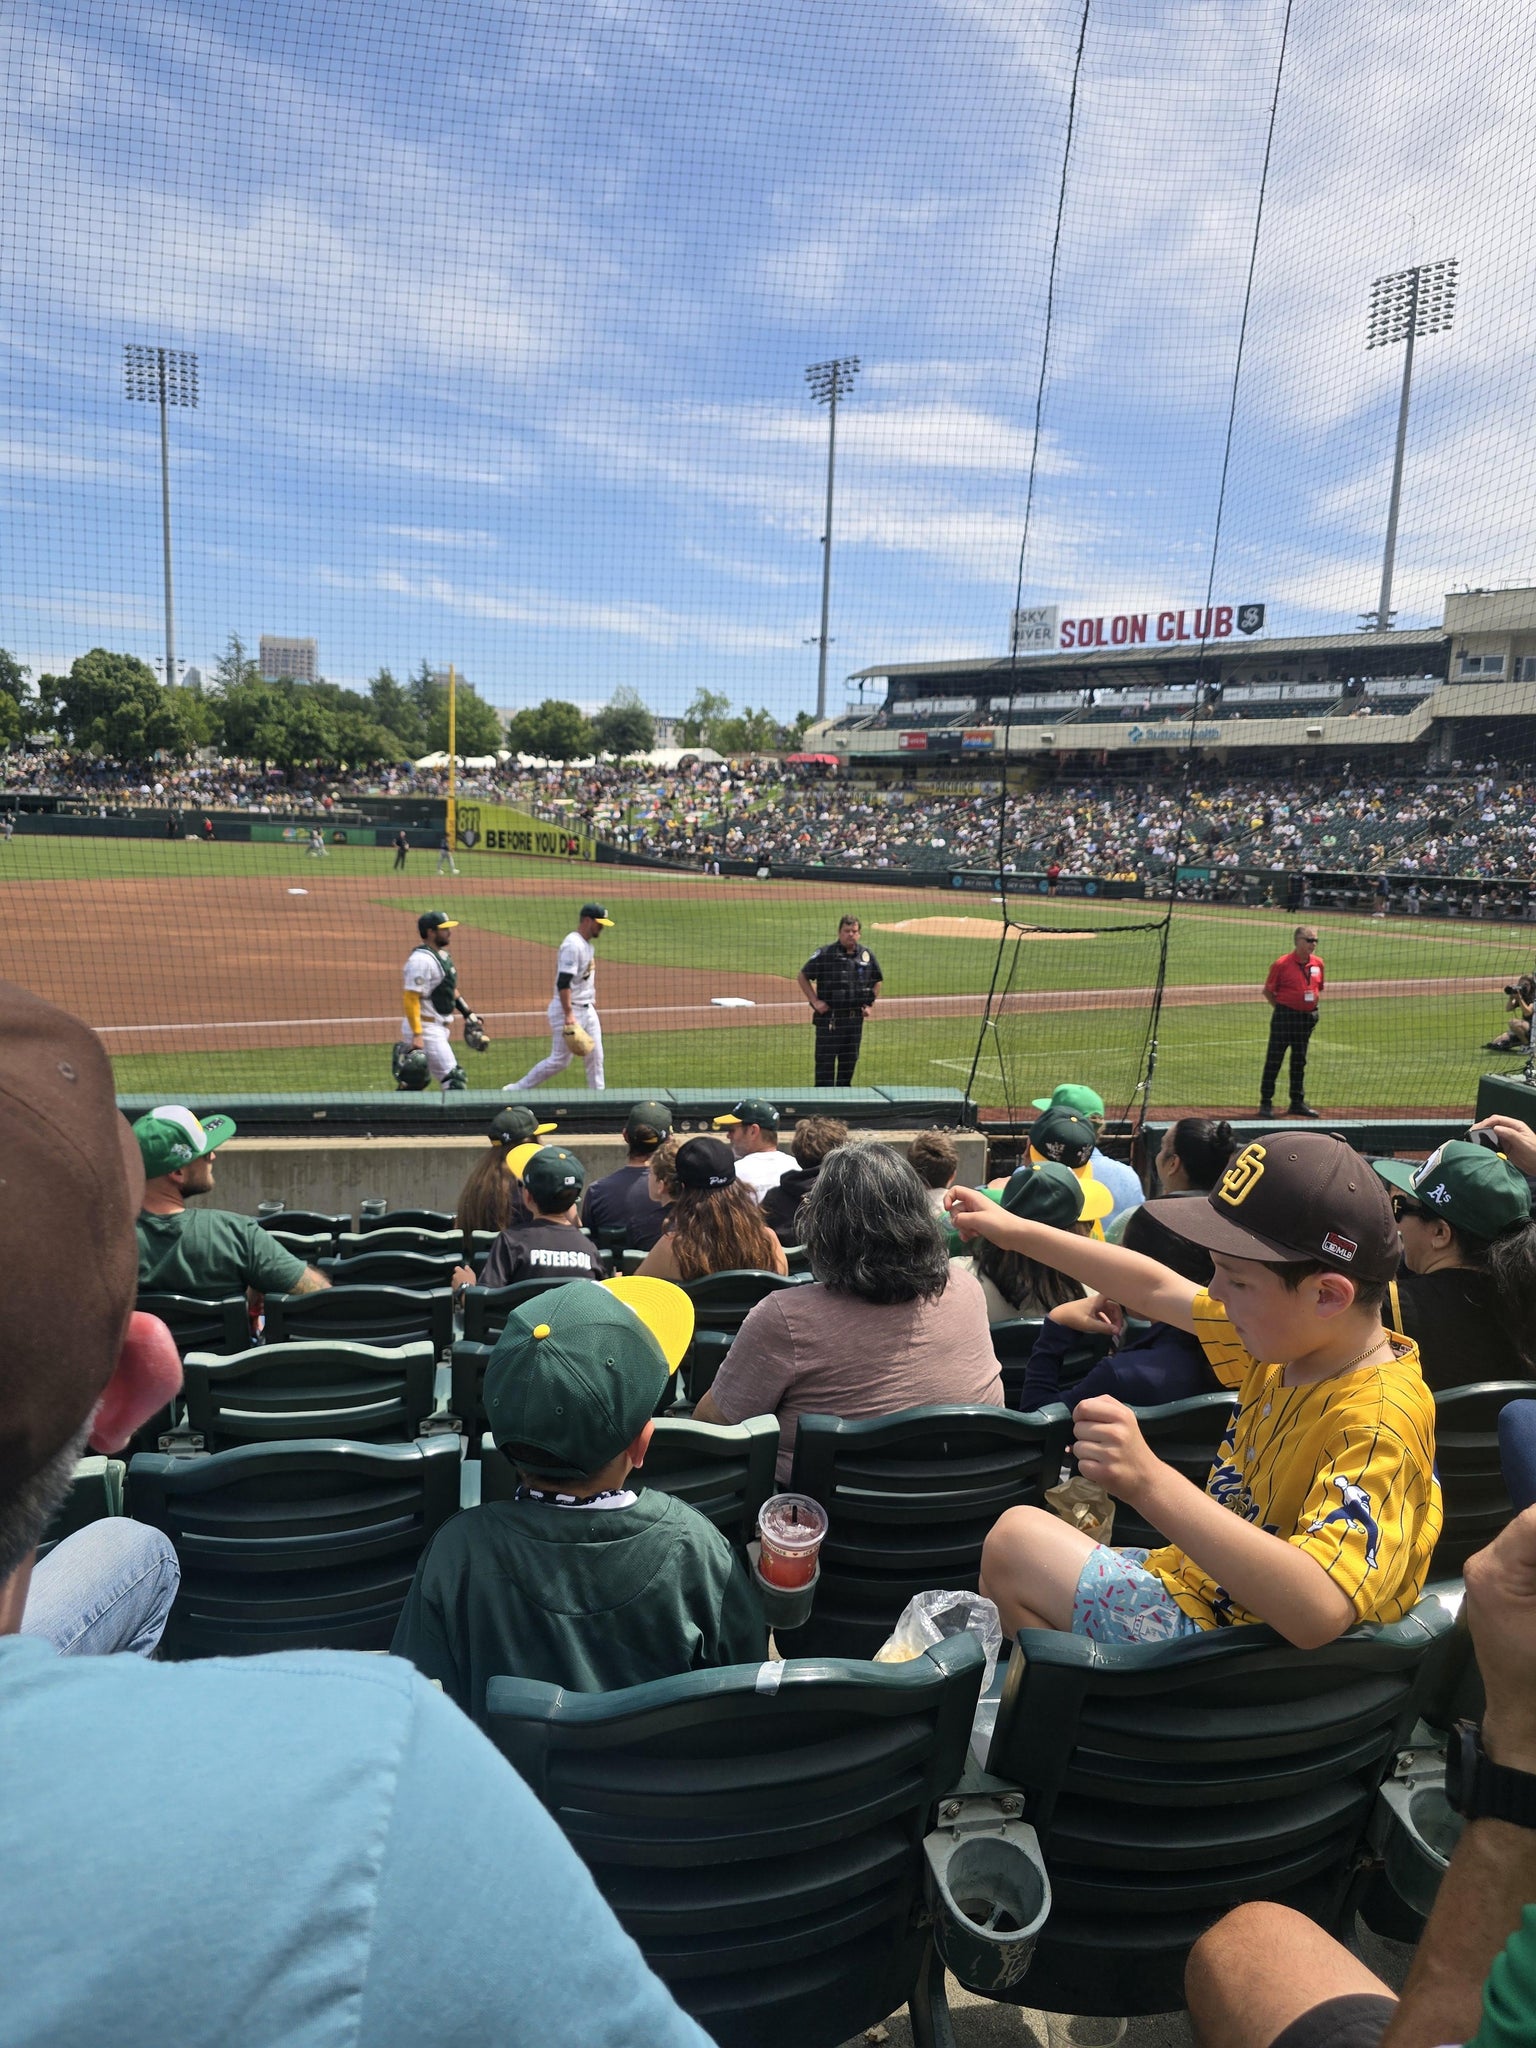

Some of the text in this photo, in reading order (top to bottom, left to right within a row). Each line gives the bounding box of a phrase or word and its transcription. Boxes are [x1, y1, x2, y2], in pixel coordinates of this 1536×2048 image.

[1020, 610, 1047, 623] SKY
[1060, 606, 1233, 648] SOLON CLUB
[486, 830, 532, 851] BEFORE
[536, 831, 556, 853] YOU
